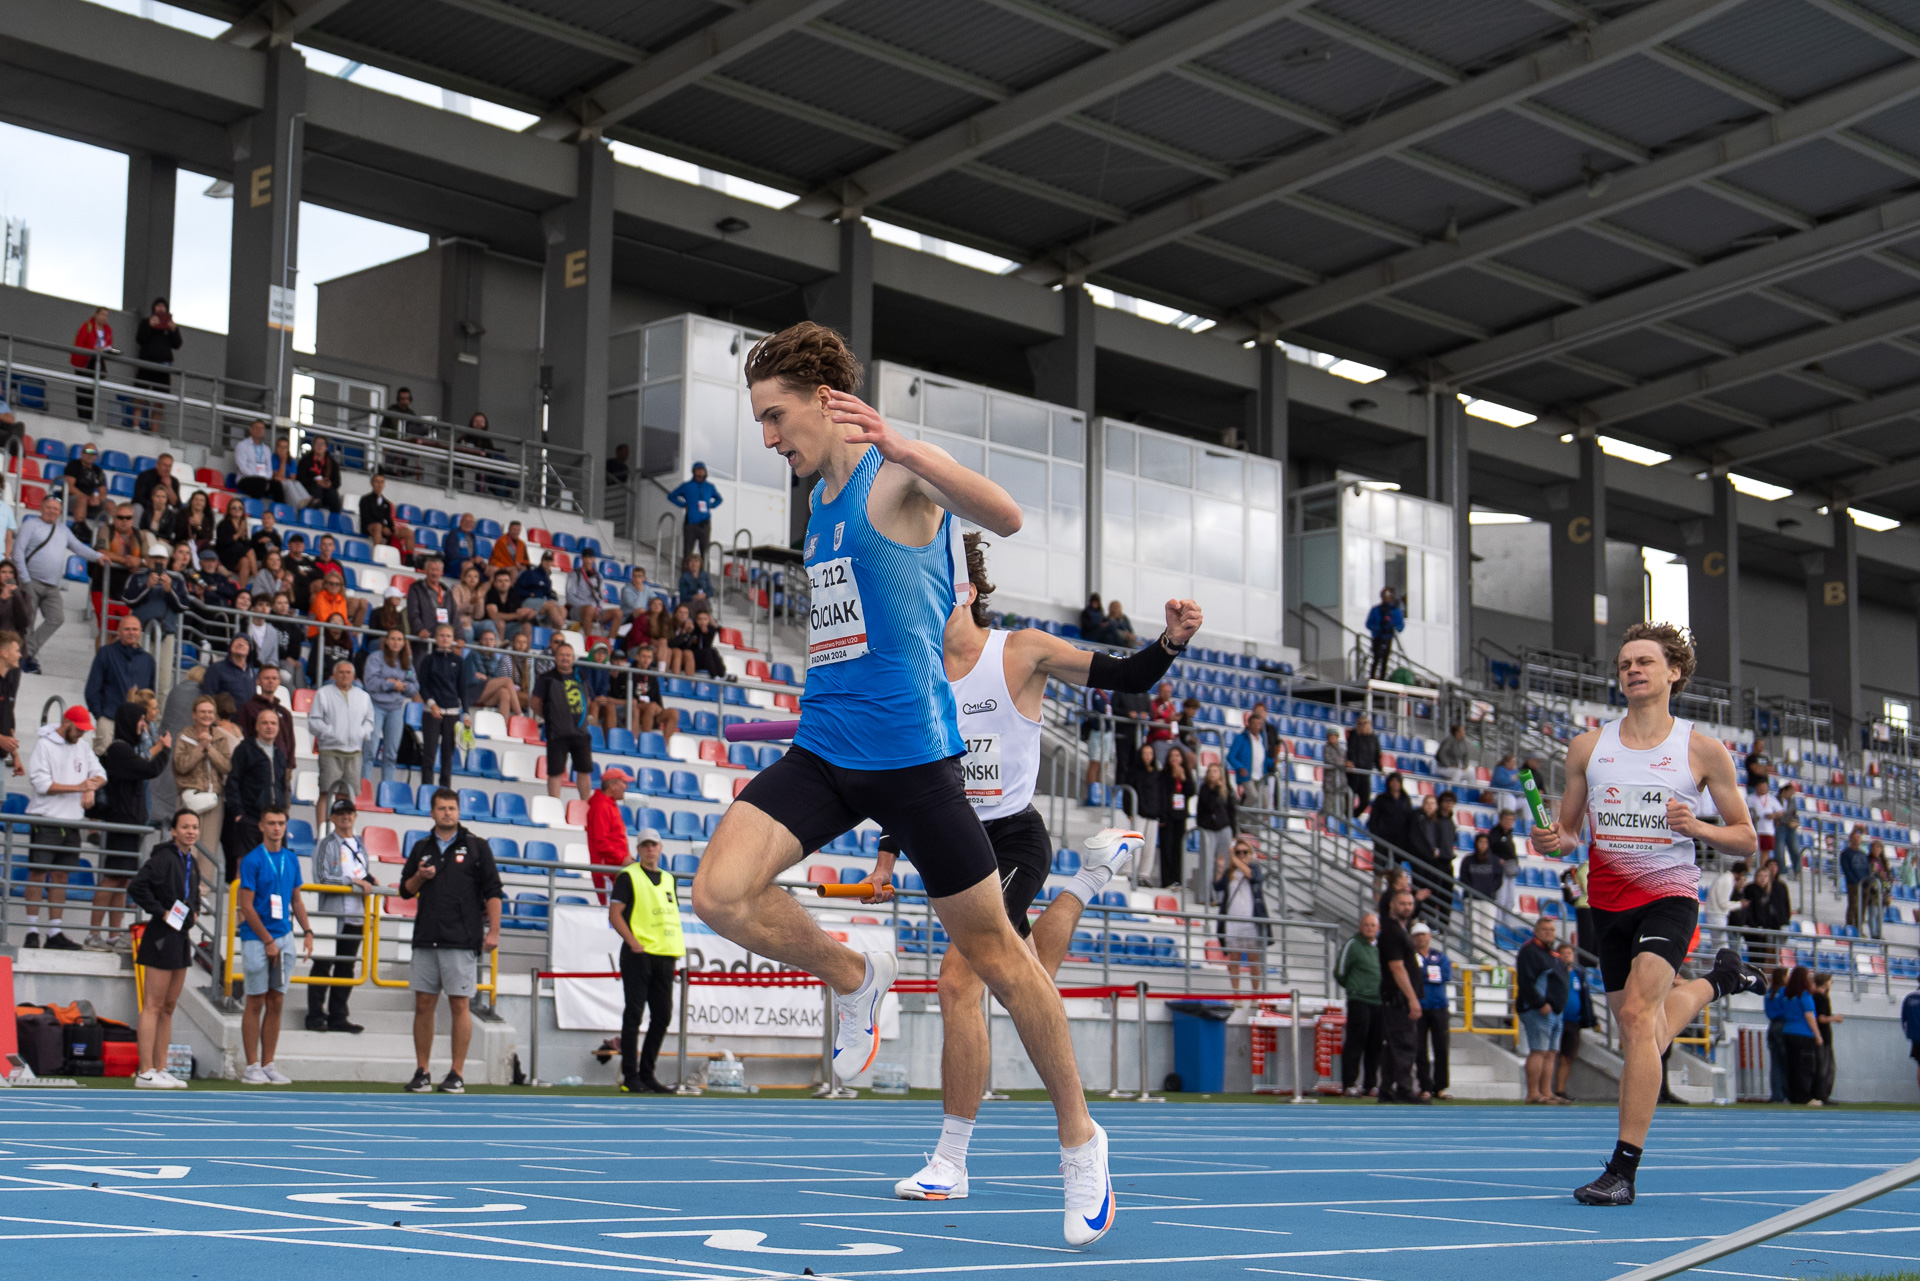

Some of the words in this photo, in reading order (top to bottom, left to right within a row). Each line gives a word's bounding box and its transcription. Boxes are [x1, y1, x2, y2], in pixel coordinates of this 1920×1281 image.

[251, 164, 273, 208] E
[565, 249, 587, 289] E
[1567, 516, 1592, 545] C
[822, 564, 848, 589] 212
[1703, 551, 1726, 577] C
[1823, 581, 1846, 606] B
[830, 649, 847, 660] 2024
[964, 738, 993, 753] 177
[1641, 791, 1662, 804] 44
[1608, 842, 1634, 850] RADOM
[1635, 843, 1653, 851] 2024
[687, 1004, 750, 1025] RADOM
[754, 1006, 824, 1027] ZASKAK
[285, 1192, 528, 1213] 3
[598, 1228, 904, 1256] 2
